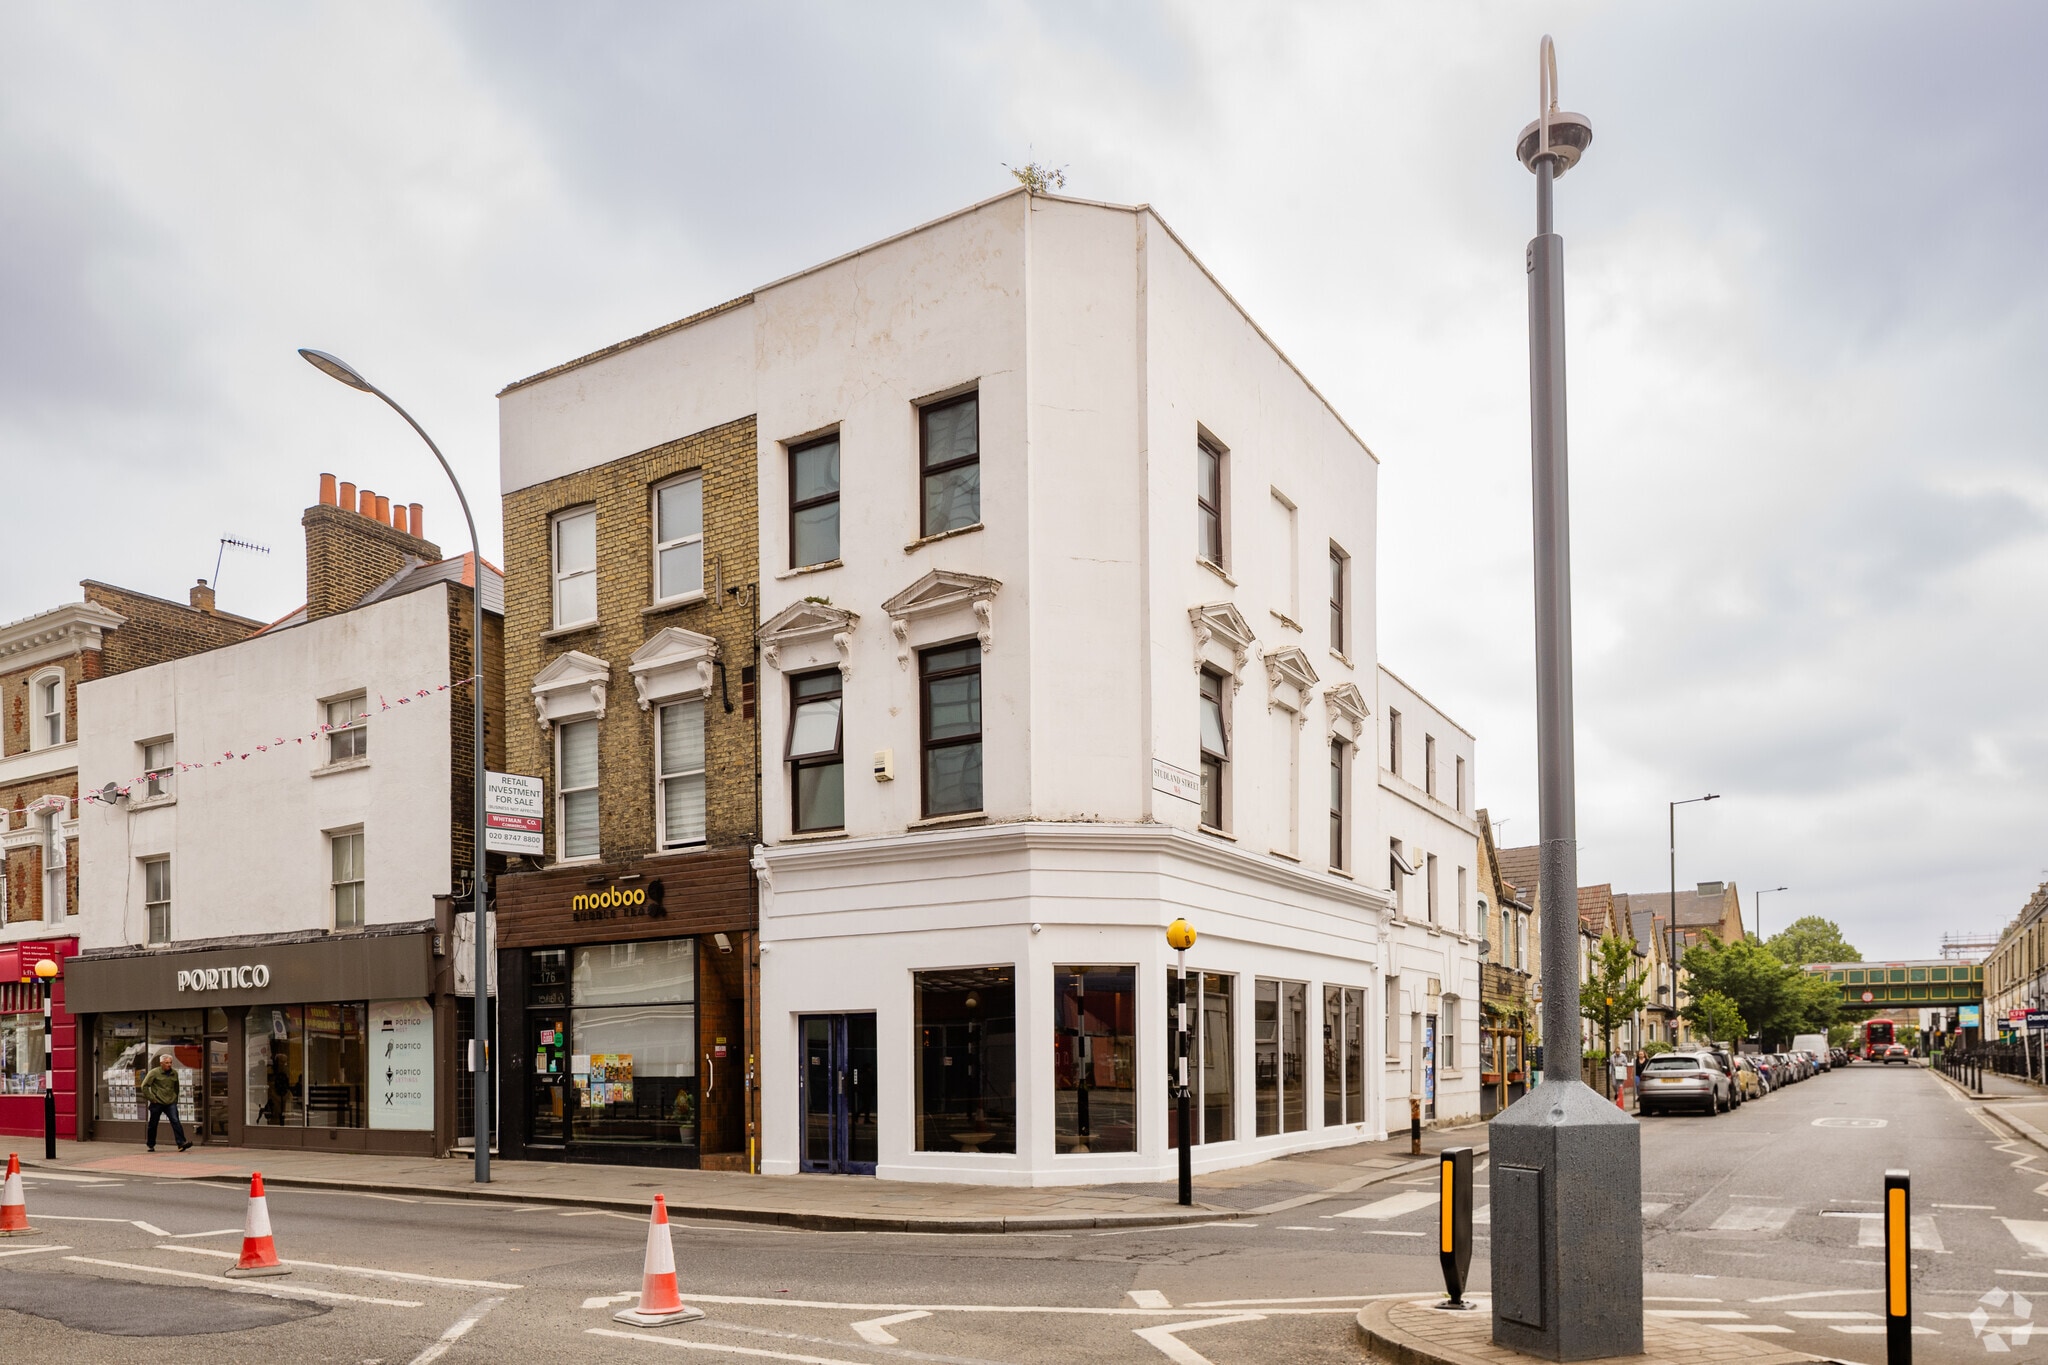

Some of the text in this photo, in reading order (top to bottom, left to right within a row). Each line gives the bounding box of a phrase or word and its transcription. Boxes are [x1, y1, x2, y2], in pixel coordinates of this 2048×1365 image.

[502, 776, 528, 786] RETAIL
[1154, 768, 1180, 785] STUDLAND
[1181, 778, 1199, 791] STREET
[488, 785, 540, 798] INVESTMENT
[496, 795, 534, 806] FOR SALE
[492, 816, 522, 824] WHITMAN
[522, 836, 540, 844] 8800
[572, 886, 646, 911] mooboo
[178, 964, 270, 992] PORTICO
[541, 972, 556, 983] 176
